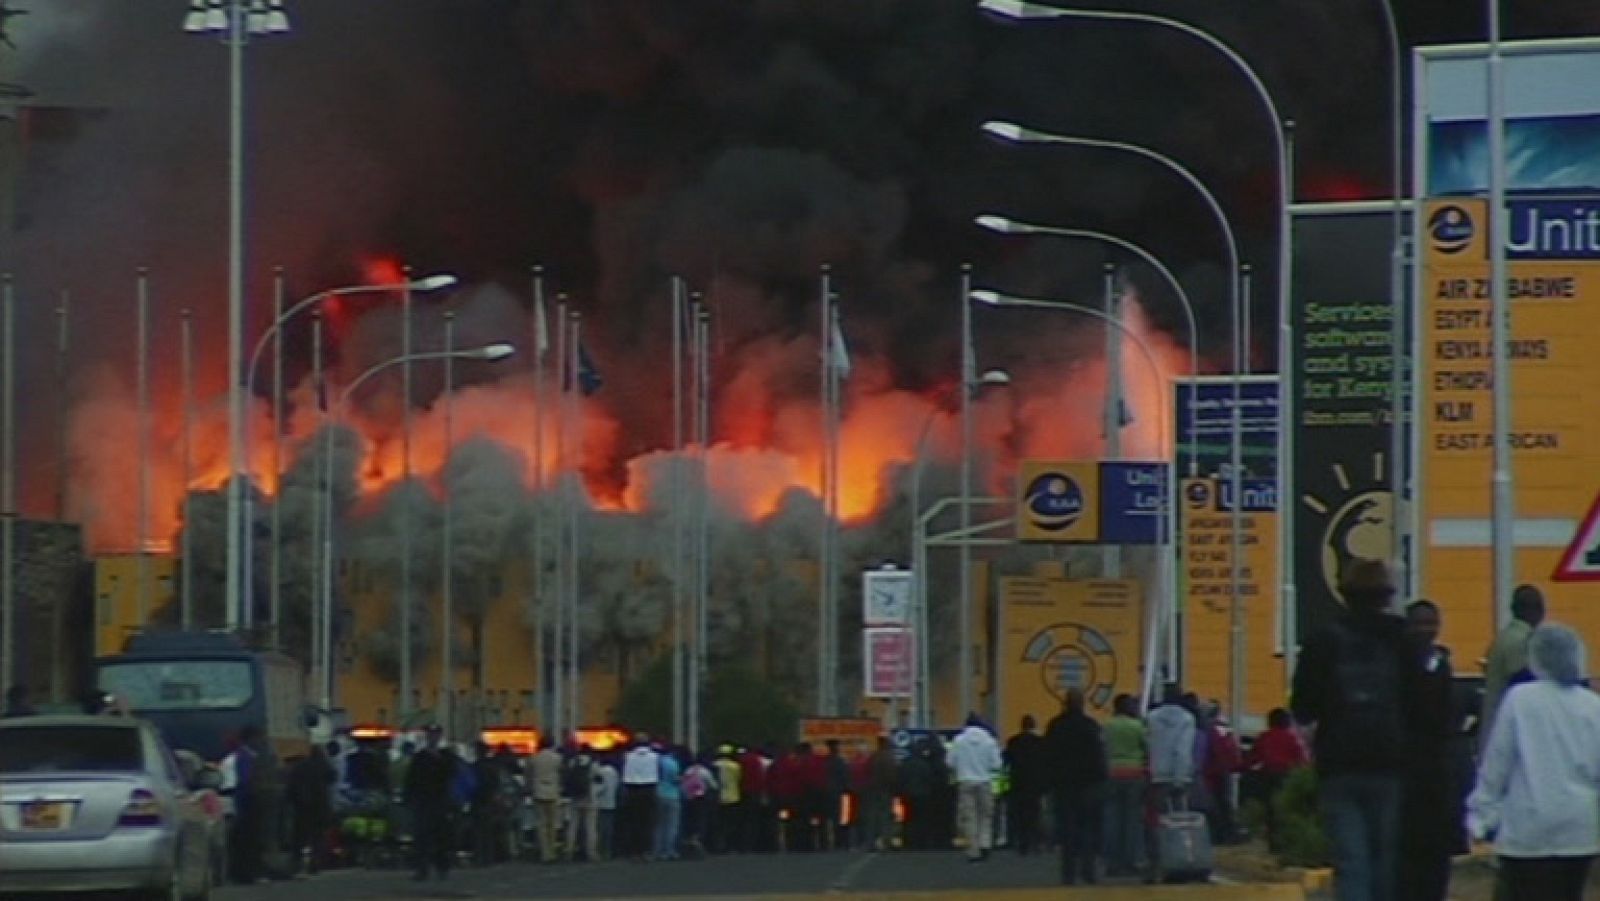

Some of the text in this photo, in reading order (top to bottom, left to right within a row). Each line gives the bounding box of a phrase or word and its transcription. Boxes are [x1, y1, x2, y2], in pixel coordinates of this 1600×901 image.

[1437, 277, 1575, 299] AIR ZIBABWE
[1435, 309, 1481, 330] EGYPT
[1436, 339, 1482, 360] KENYA
[1303, 353, 1349, 373] and
[1435, 402, 1474, 421] KLM
[1435, 433, 1558, 450] EAST ARICAN
